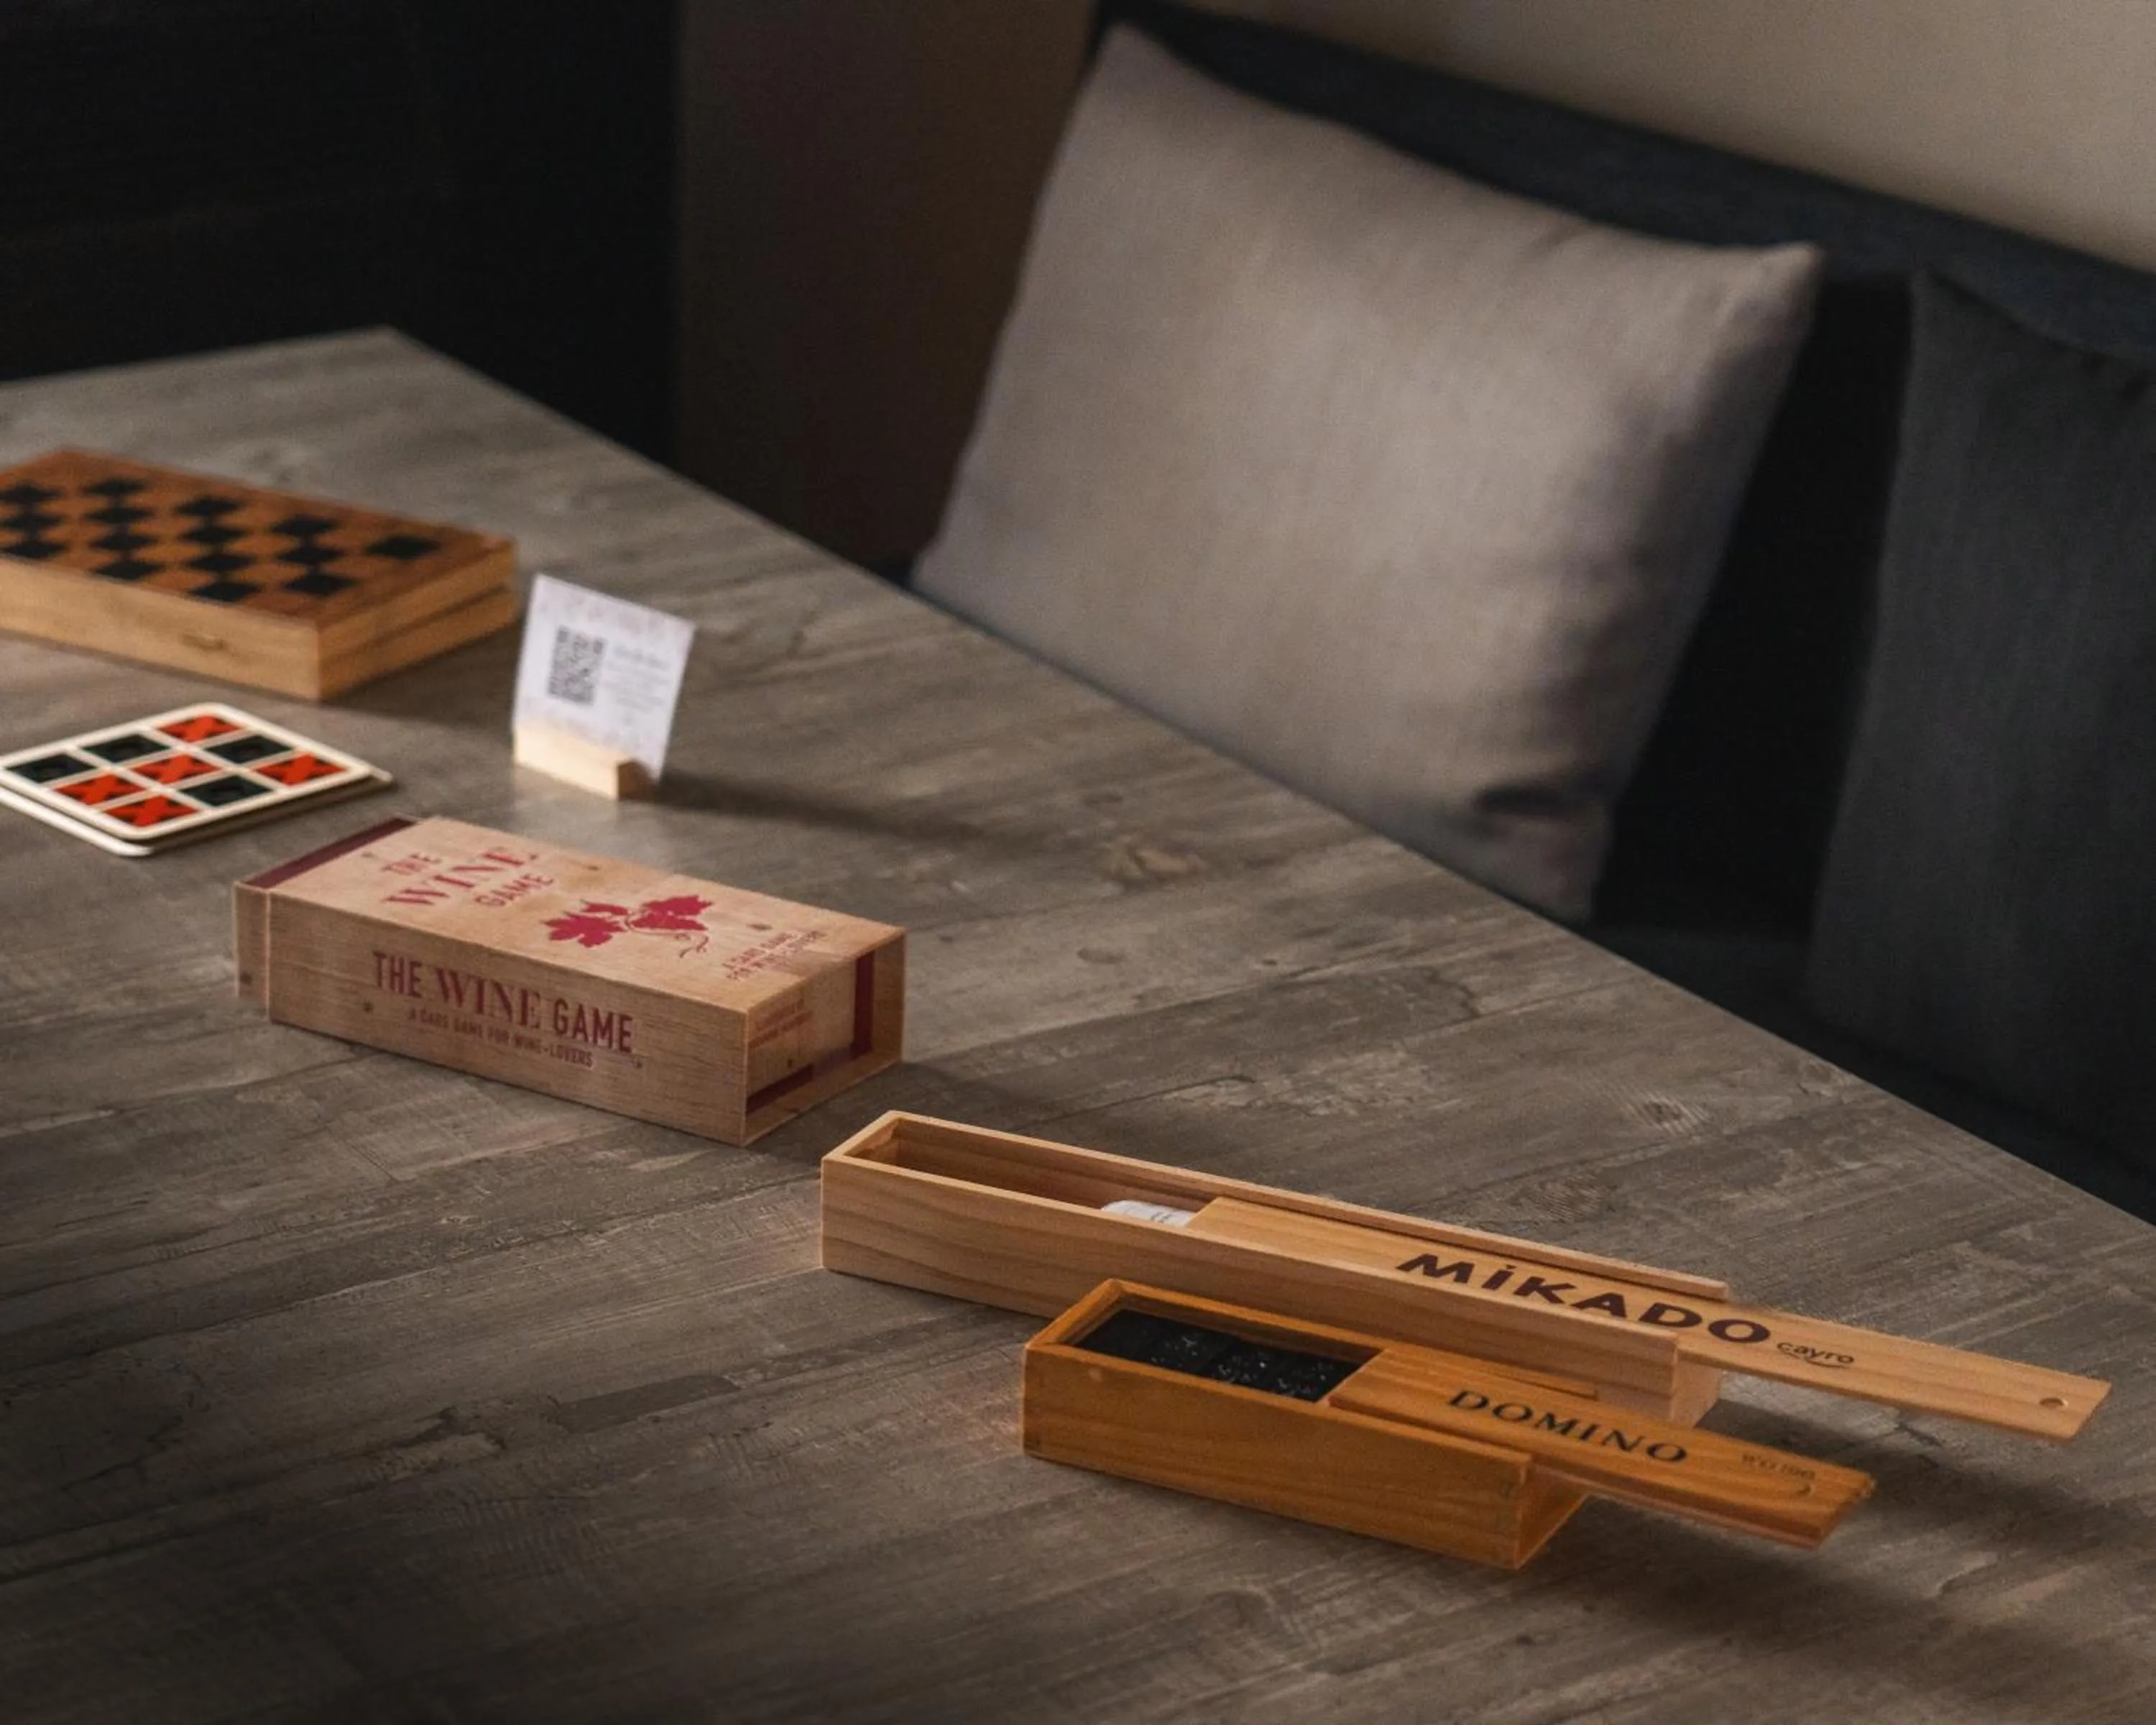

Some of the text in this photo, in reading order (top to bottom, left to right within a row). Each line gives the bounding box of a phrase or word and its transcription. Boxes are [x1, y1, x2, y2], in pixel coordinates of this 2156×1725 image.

[381, 852, 443, 875] THE
[383, 847, 538, 906] WINE
[474, 873, 554, 906] GAME
[373, 950, 634, 1053] THE WINE GAME
[1777, 1342, 1855, 1366] cayro
[1448, 1389, 1689, 1463] DOMINO
